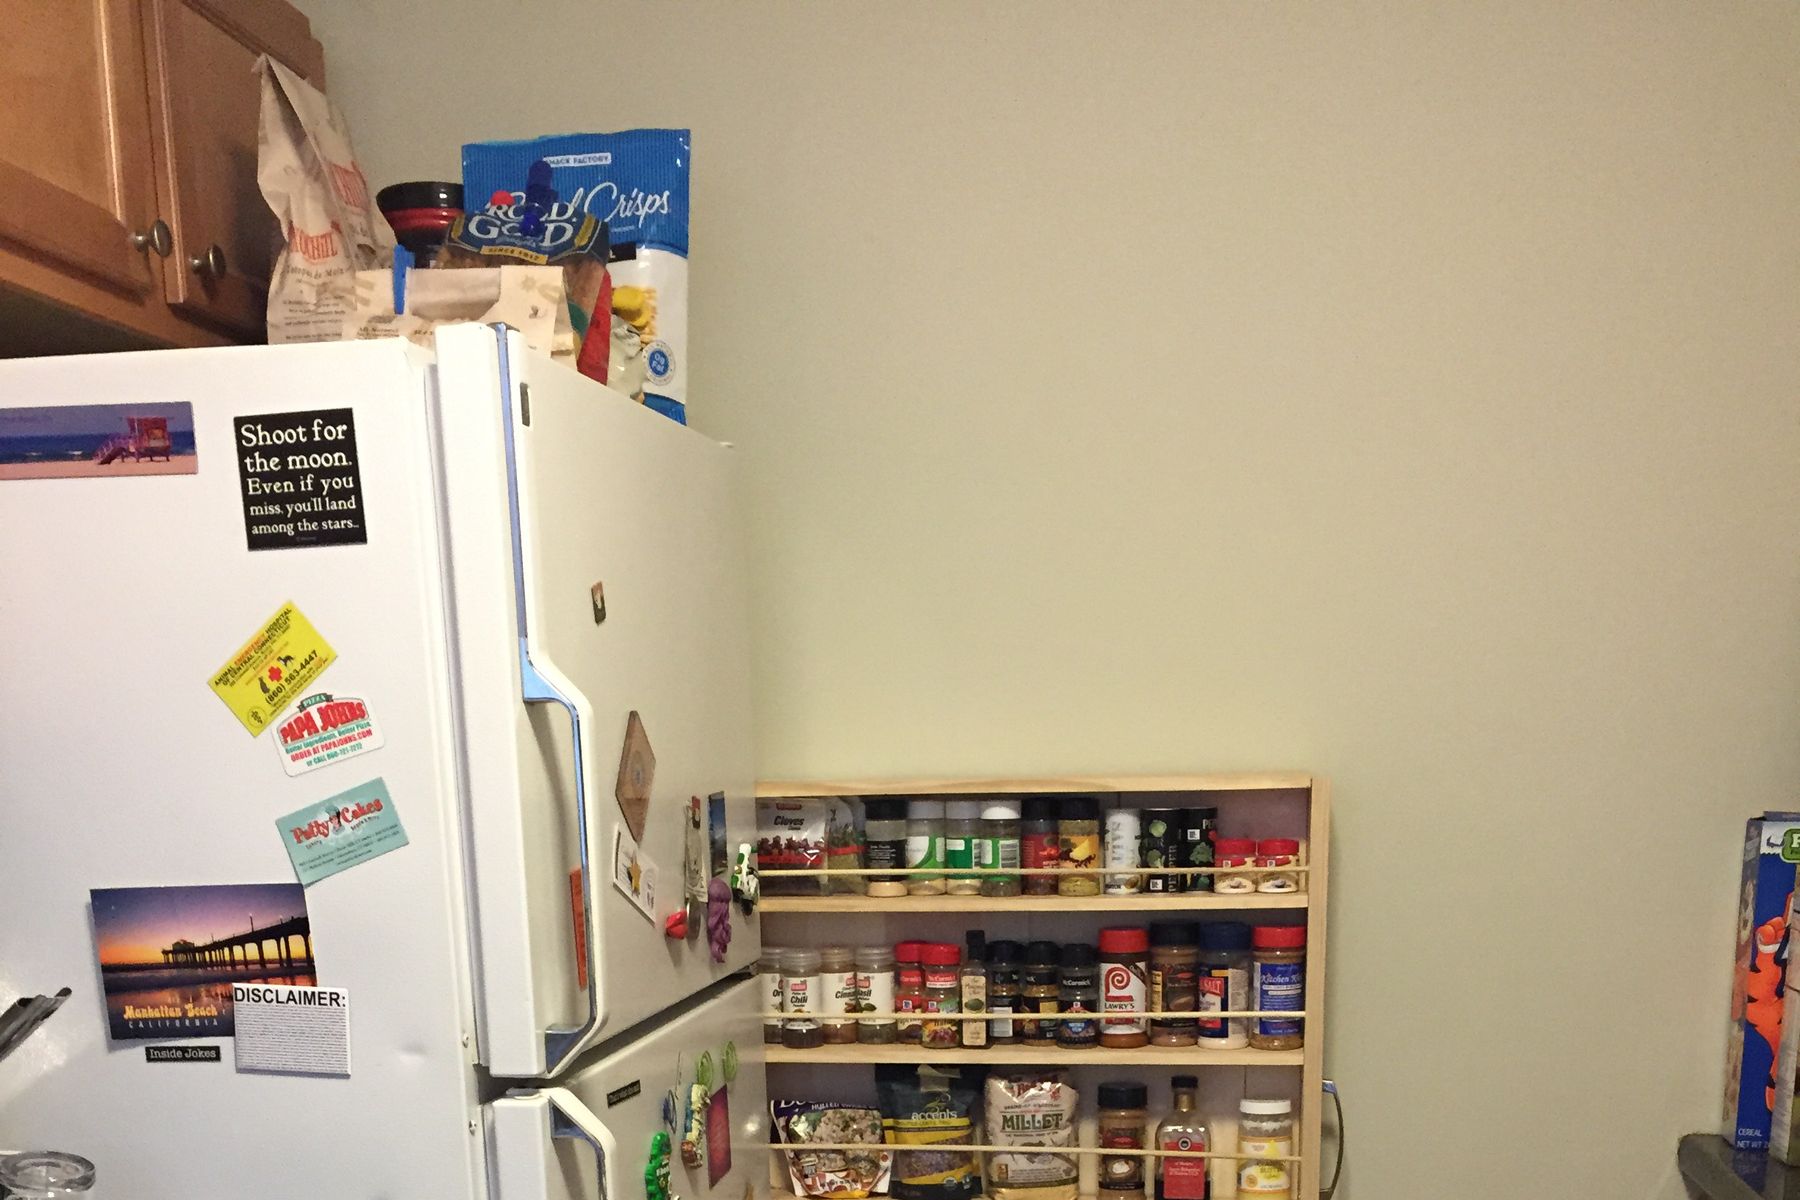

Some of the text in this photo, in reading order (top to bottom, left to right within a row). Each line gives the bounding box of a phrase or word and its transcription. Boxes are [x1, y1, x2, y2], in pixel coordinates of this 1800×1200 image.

[584, 182, 671, 228] Crisps
[240, 419, 348, 447] Shoot for
[244, 451, 281, 472] the
[246, 474, 355, 495] Even if you
[285, 497, 322, 518] you'll
[325, 495, 357, 511] land
[251, 523, 295, 536] among
[297, 518, 319, 532] the
[215, 666, 233, 686] ANIMAL
[281, 711, 319, 743] PAPA
[291, 748, 312, 762] ORDER
[341, 799, 383, 823] Cakes
[774, 815, 805, 826] Cloves
[234, 987, 346, 1007] DISCLAIMER:
[790, 995, 808, 1005] Chili
[1104, 1002, 1135, 1010] LAWRY'S
[123, 1002, 218, 1020] Manhattan Beach
[128, 1019, 219, 1029] CALIFORNIA
[149, 1049, 217, 1059] Inside Jokes
[911, 1109, 958, 1120] accents
[1001, 1113, 1063, 1131] MILLET
[1737, 1128, 1763, 1137] CEREAL
